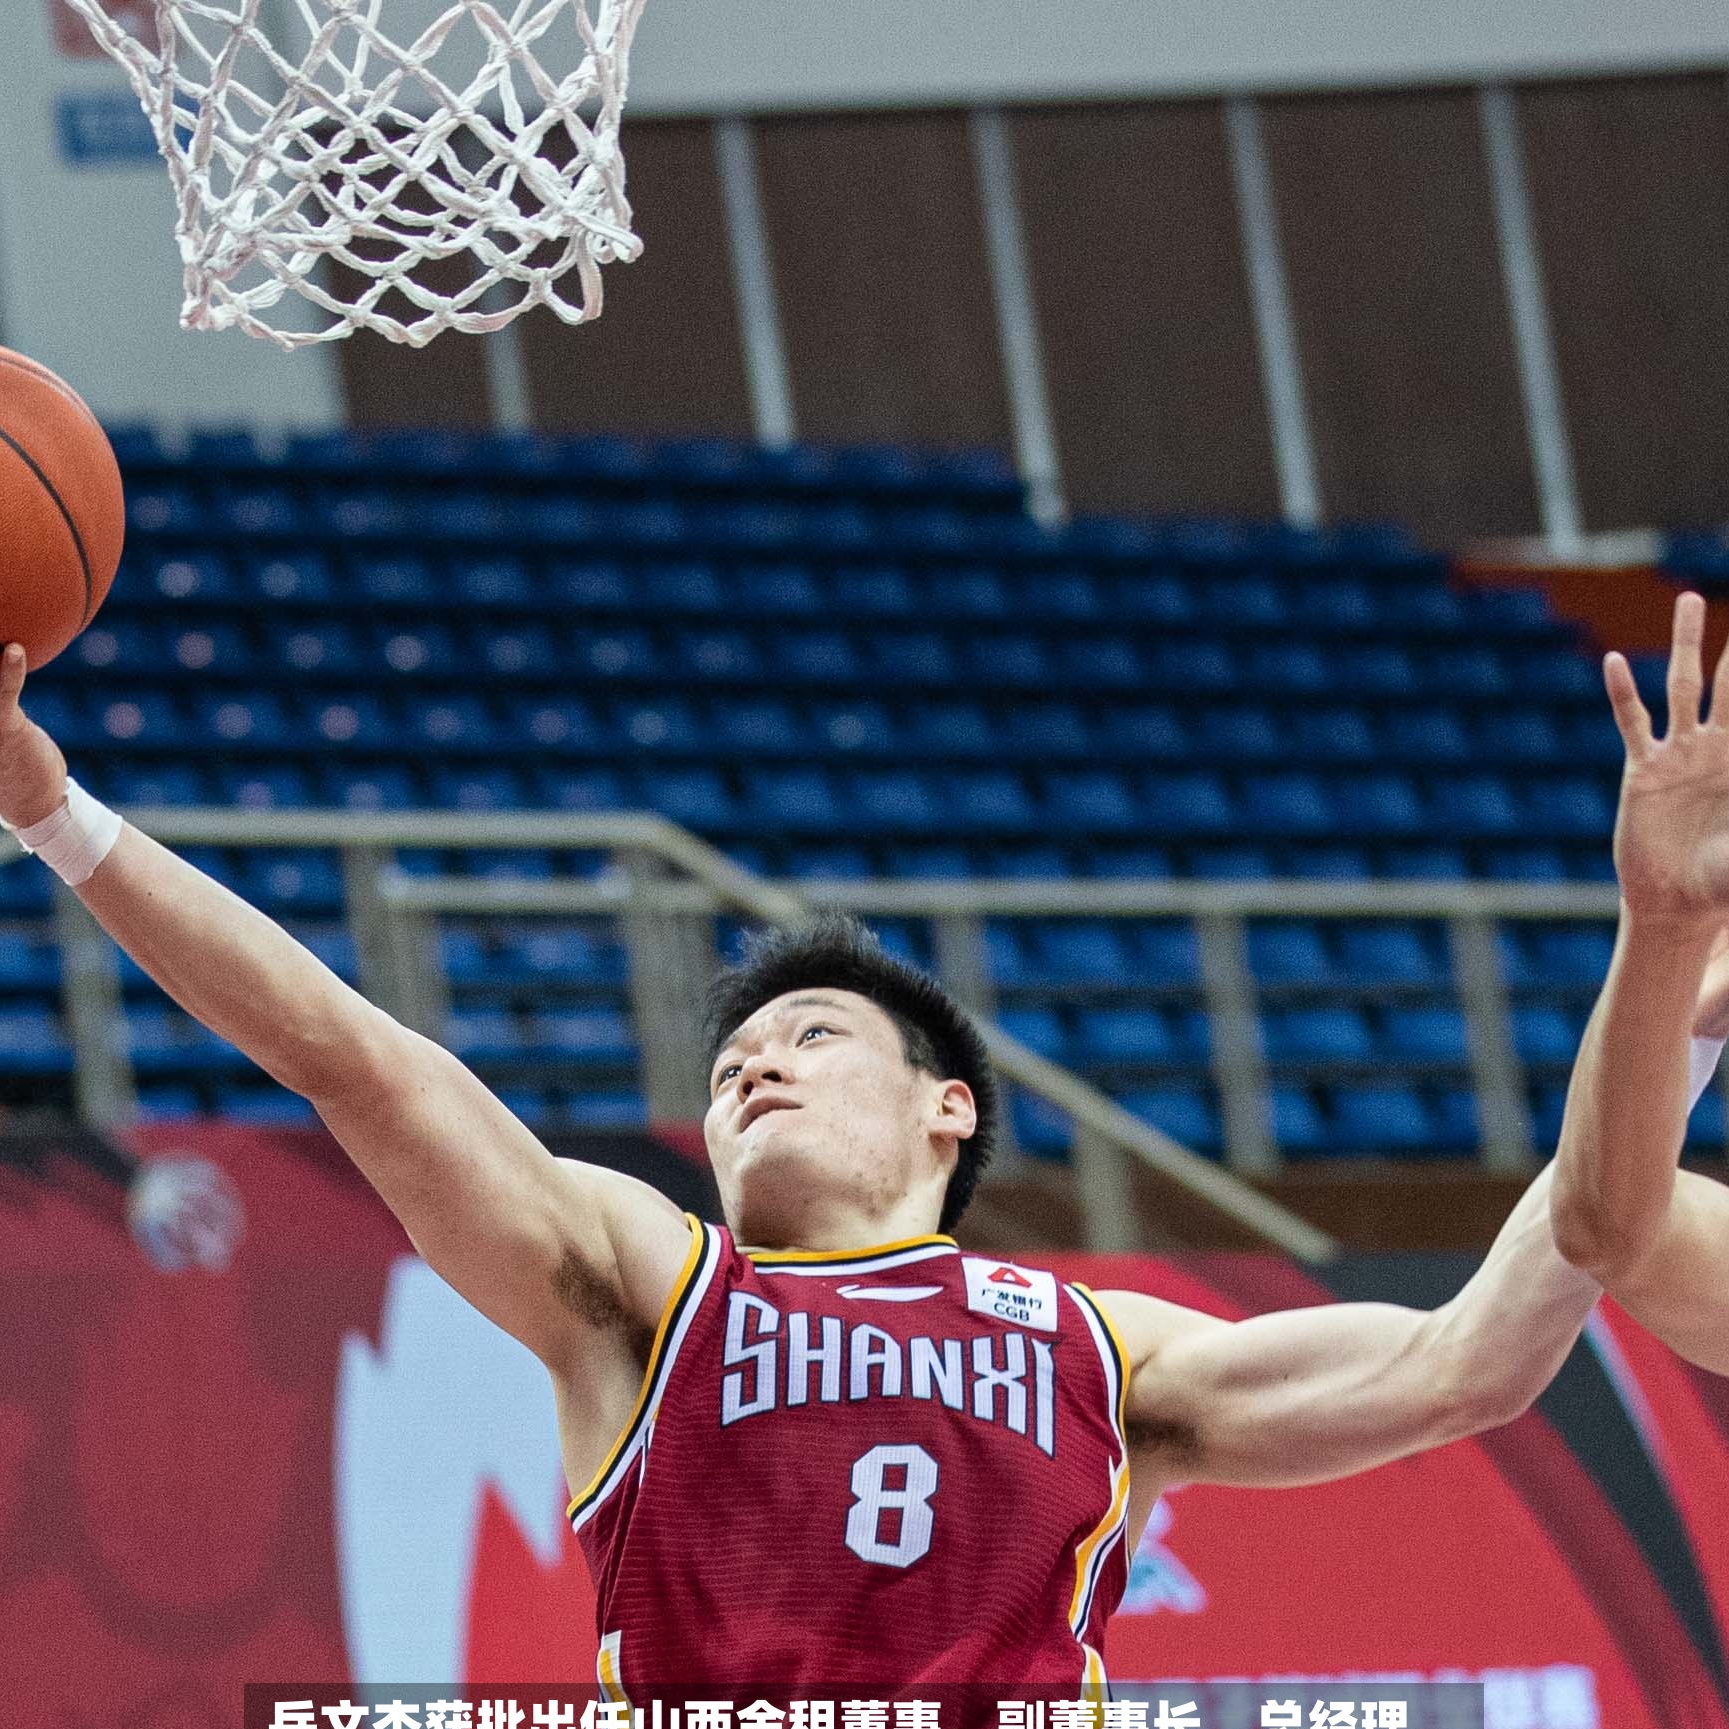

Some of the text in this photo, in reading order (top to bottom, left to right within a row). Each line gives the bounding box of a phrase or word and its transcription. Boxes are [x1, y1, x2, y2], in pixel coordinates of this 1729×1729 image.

[720, 1289, 1060, 1458] SHANXI
[994, 1302, 1030, 1321] CGB
[843, 1442, 939, 1569] 8
